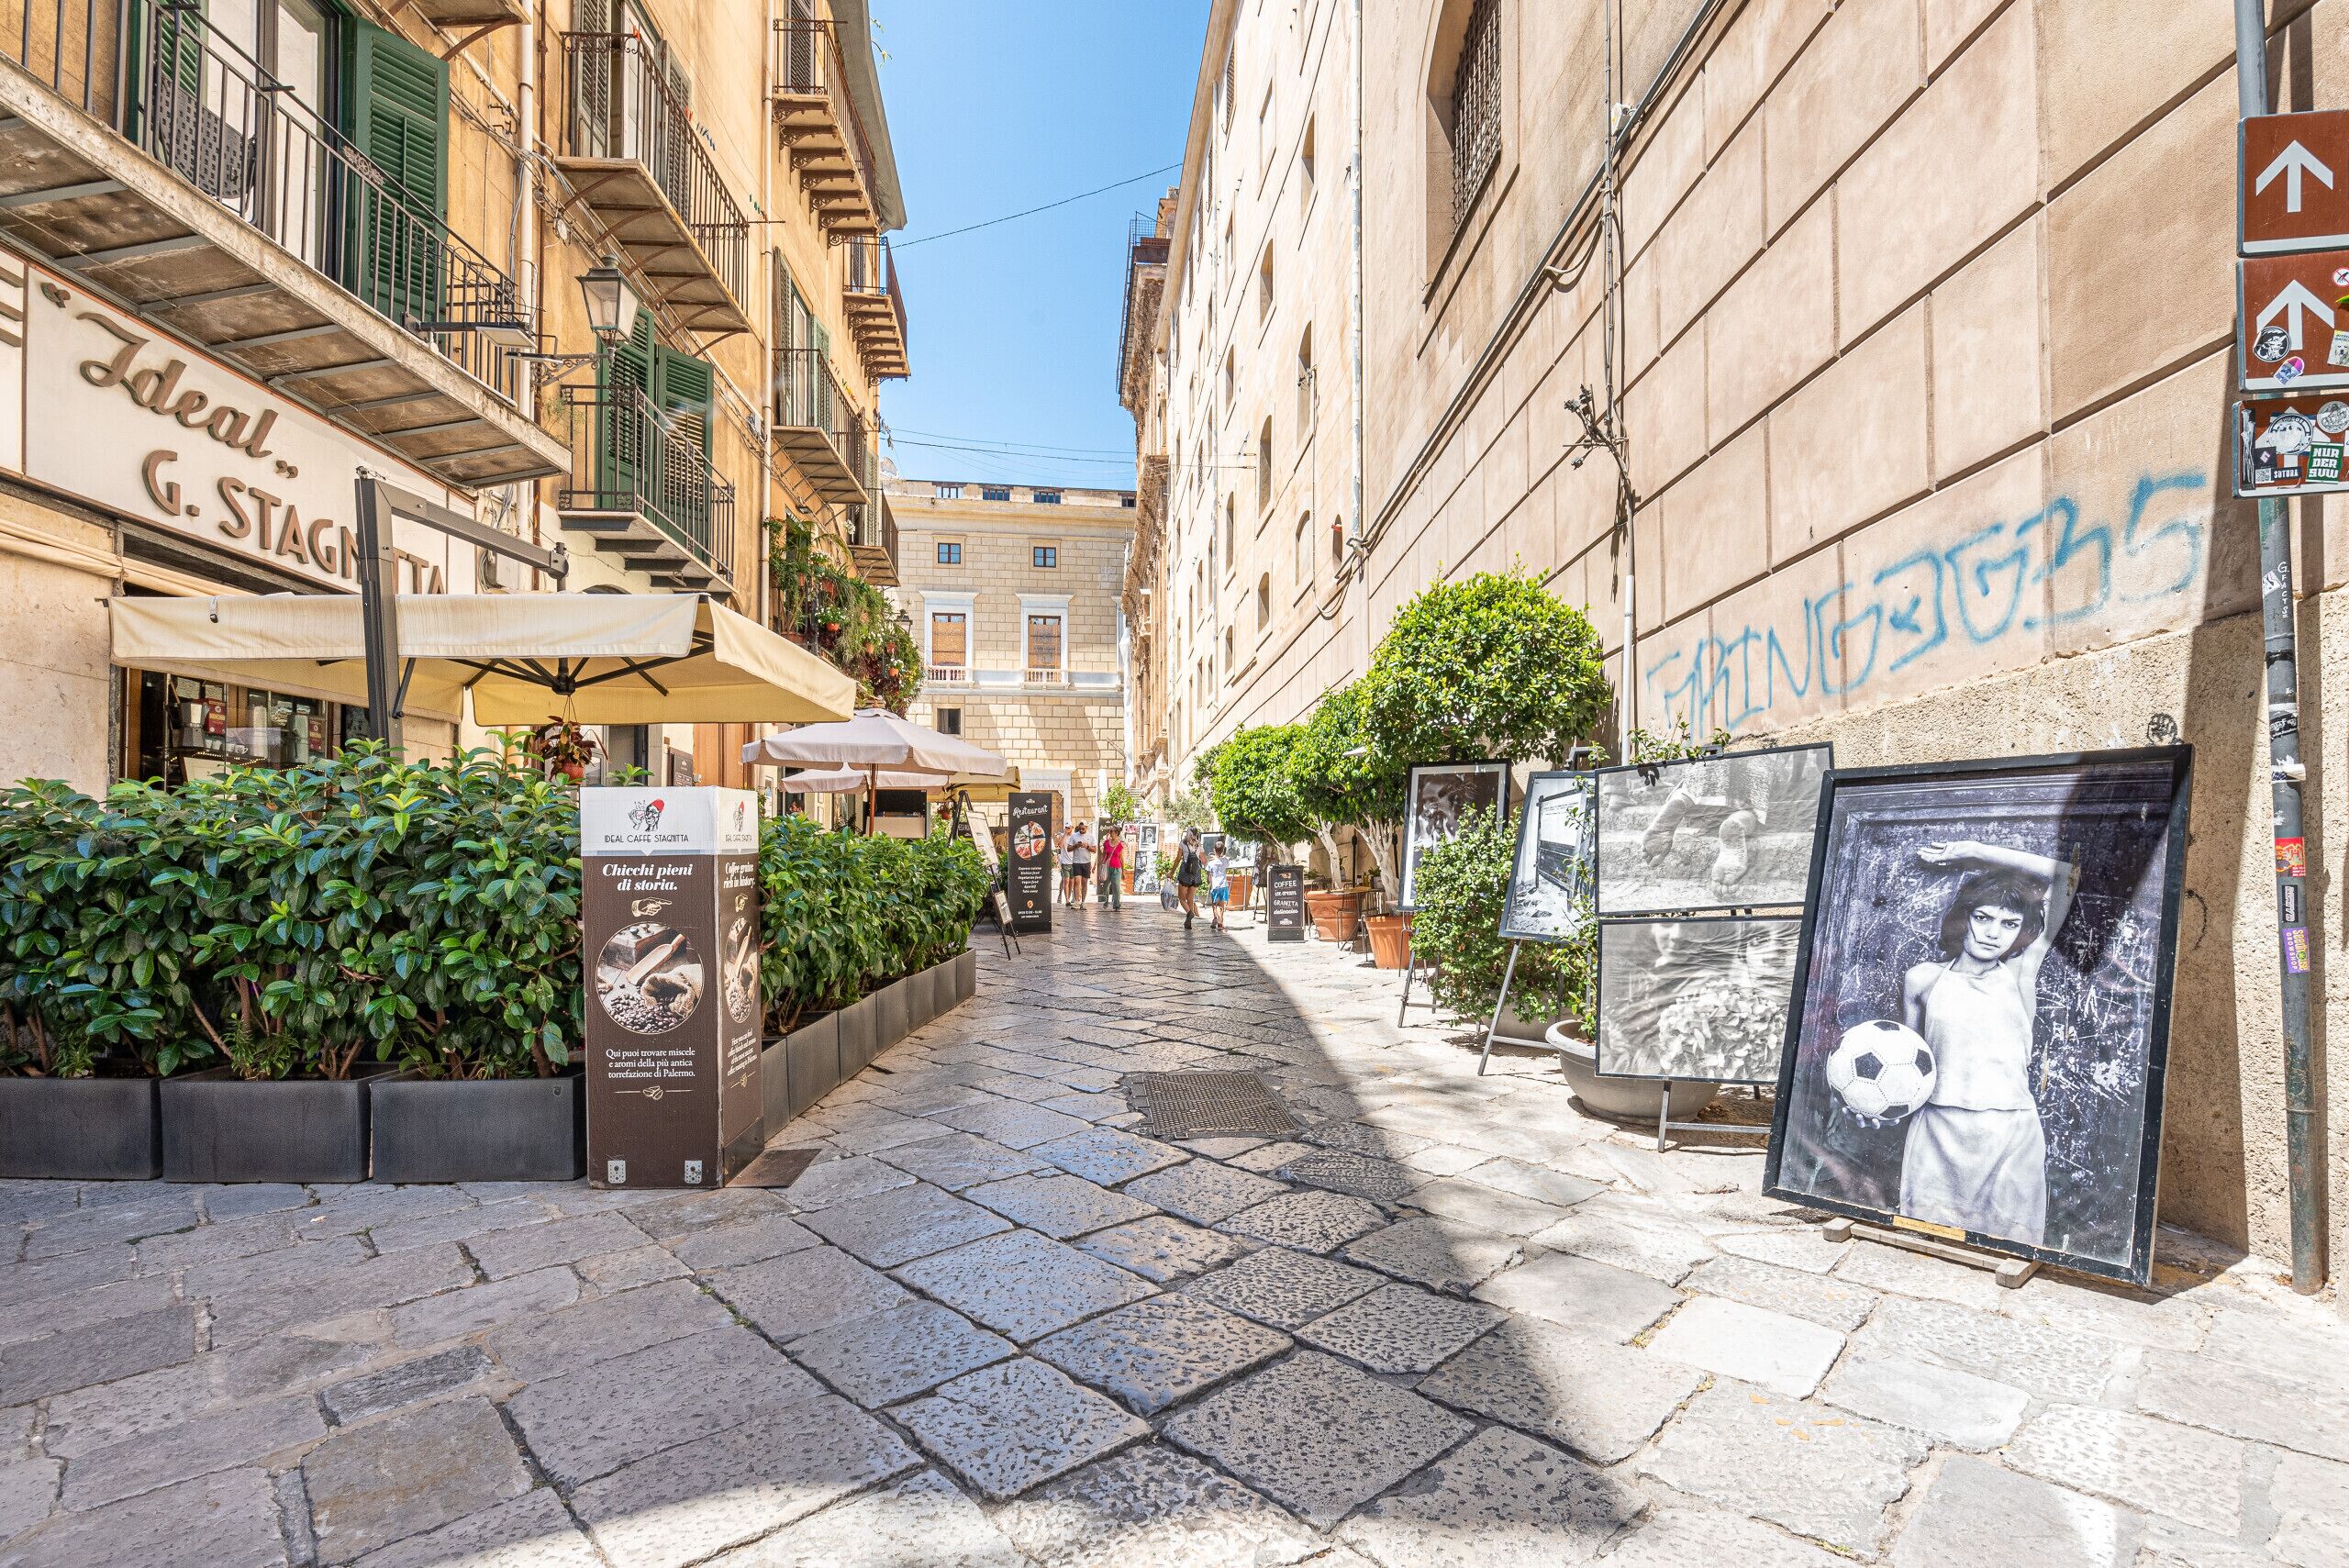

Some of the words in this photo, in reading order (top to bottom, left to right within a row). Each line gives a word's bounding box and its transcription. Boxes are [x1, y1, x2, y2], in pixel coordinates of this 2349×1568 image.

[2312, 448, 2340, 458] NUR
[2311, 458, 2338, 468] DER
[141, 450, 201, 517] G.
[217, 477, 446, 595] STAGNTTA
[1012, 805, 1048, 818] Restaurant
[604, 834, 623, 843] IDEAL
[654, 834, 689, 843] STAGNITTA
[602, 863, 654, 876] Chicchi
[656, 863, 694, 879] pieni
[725, 862, 740, 876] Coffee
[617, 878, 631, 891] di
[634, 878, 678, 891] storia.
[723, 876, 733, 888] rich
[1275, 880, 1297, 888] COFFEE
[606, 1049, 621, 1060] Qui
[622, 1049, 640, 1060] puoi
[668, 1047, 696, 1057] miscele
[614, 1060, 636, 1068] aromi
[637, 1058, 655, 1067] della
[656, 1059, 669, 1070] più
[670, 1059, 693, 1067] antica
[608, 1069, 652, 1079] torrefazione
[653, 1067, 662, 1078] di
[663, 1069, 696, 1078] Palermo.
